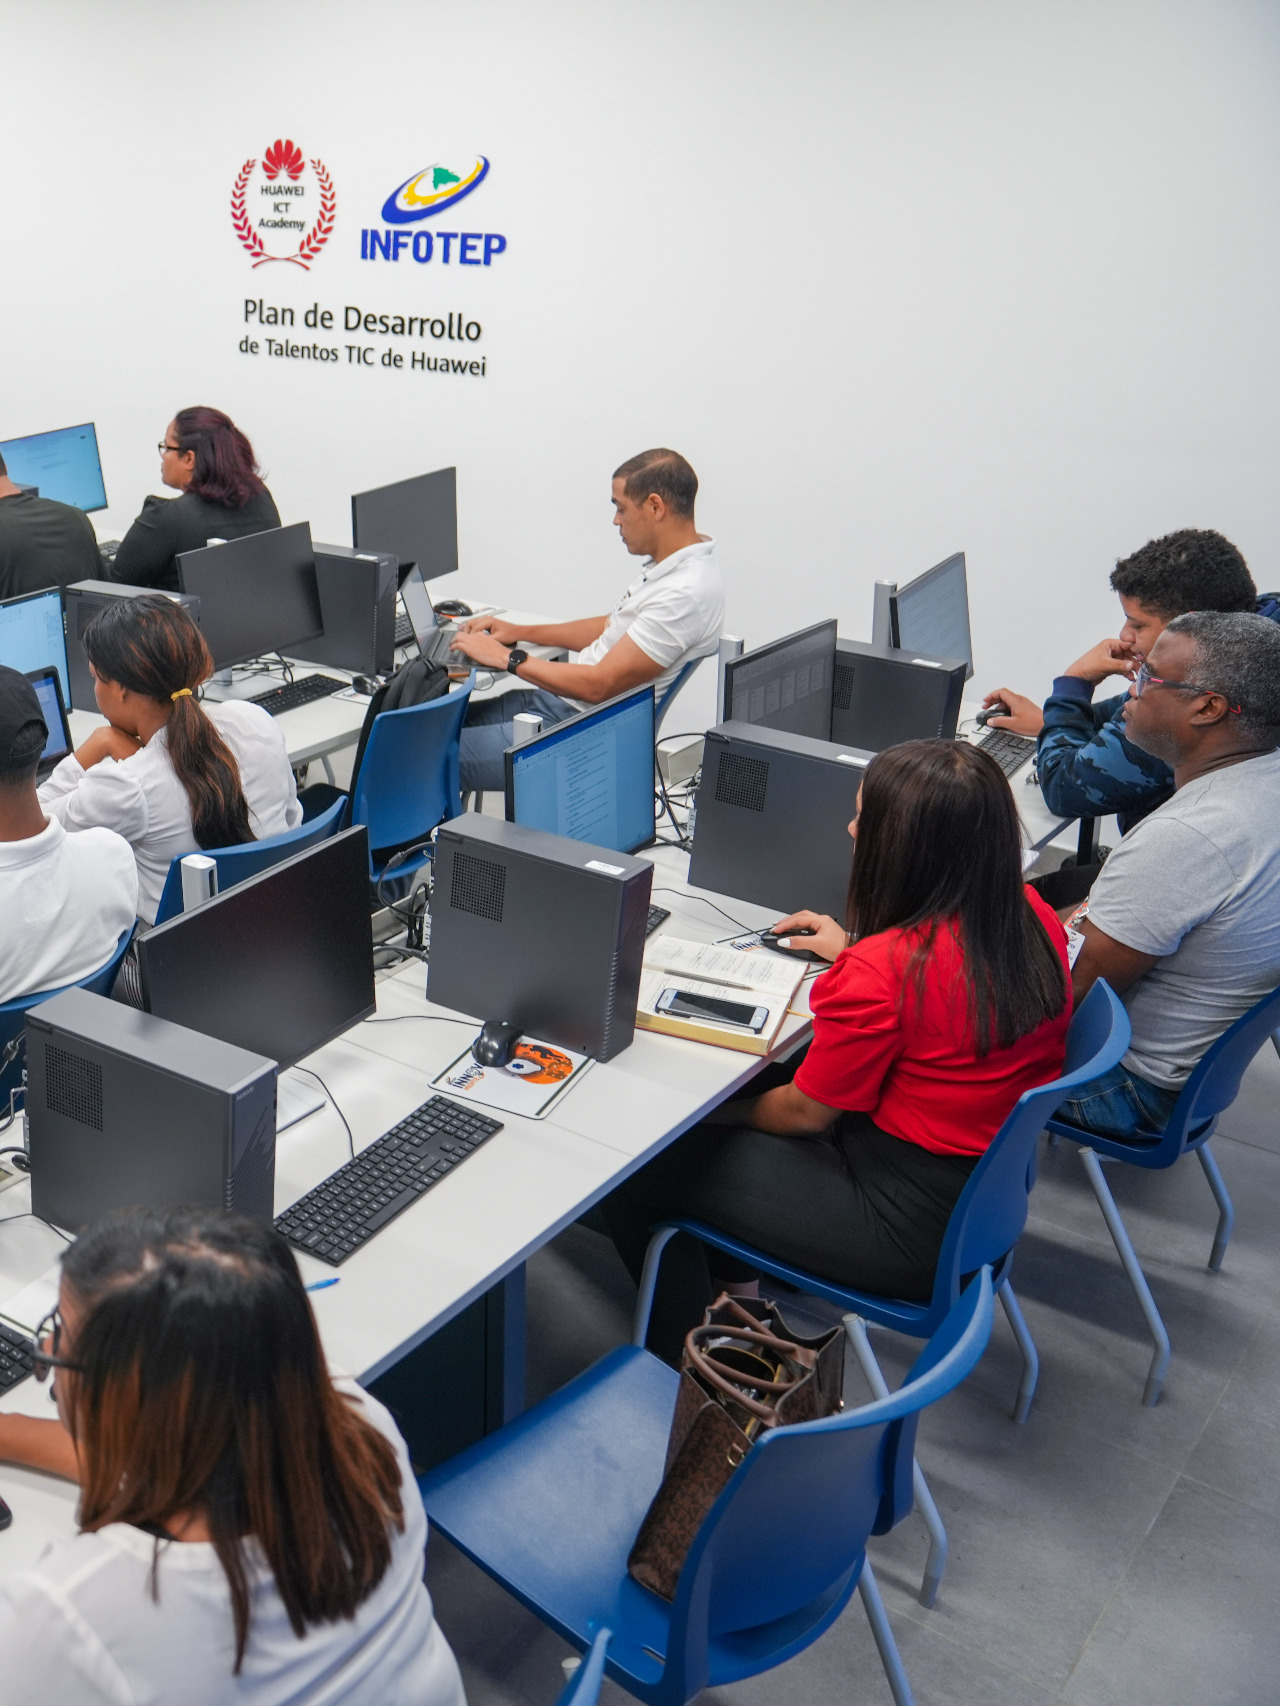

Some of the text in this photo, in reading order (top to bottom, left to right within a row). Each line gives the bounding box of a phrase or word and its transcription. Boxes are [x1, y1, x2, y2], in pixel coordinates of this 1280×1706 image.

[261, 185, 305, 196] HUAWEI
[273, 202, 291, 213] ICT
[258, 217, 305, 232] Academy
[360, 229, 507, 266] INFOTEP
[244, 299, 482, 342] Plan de Desarrollo
[239, 335, 486, 377] de Talentos TIC de Huawei
